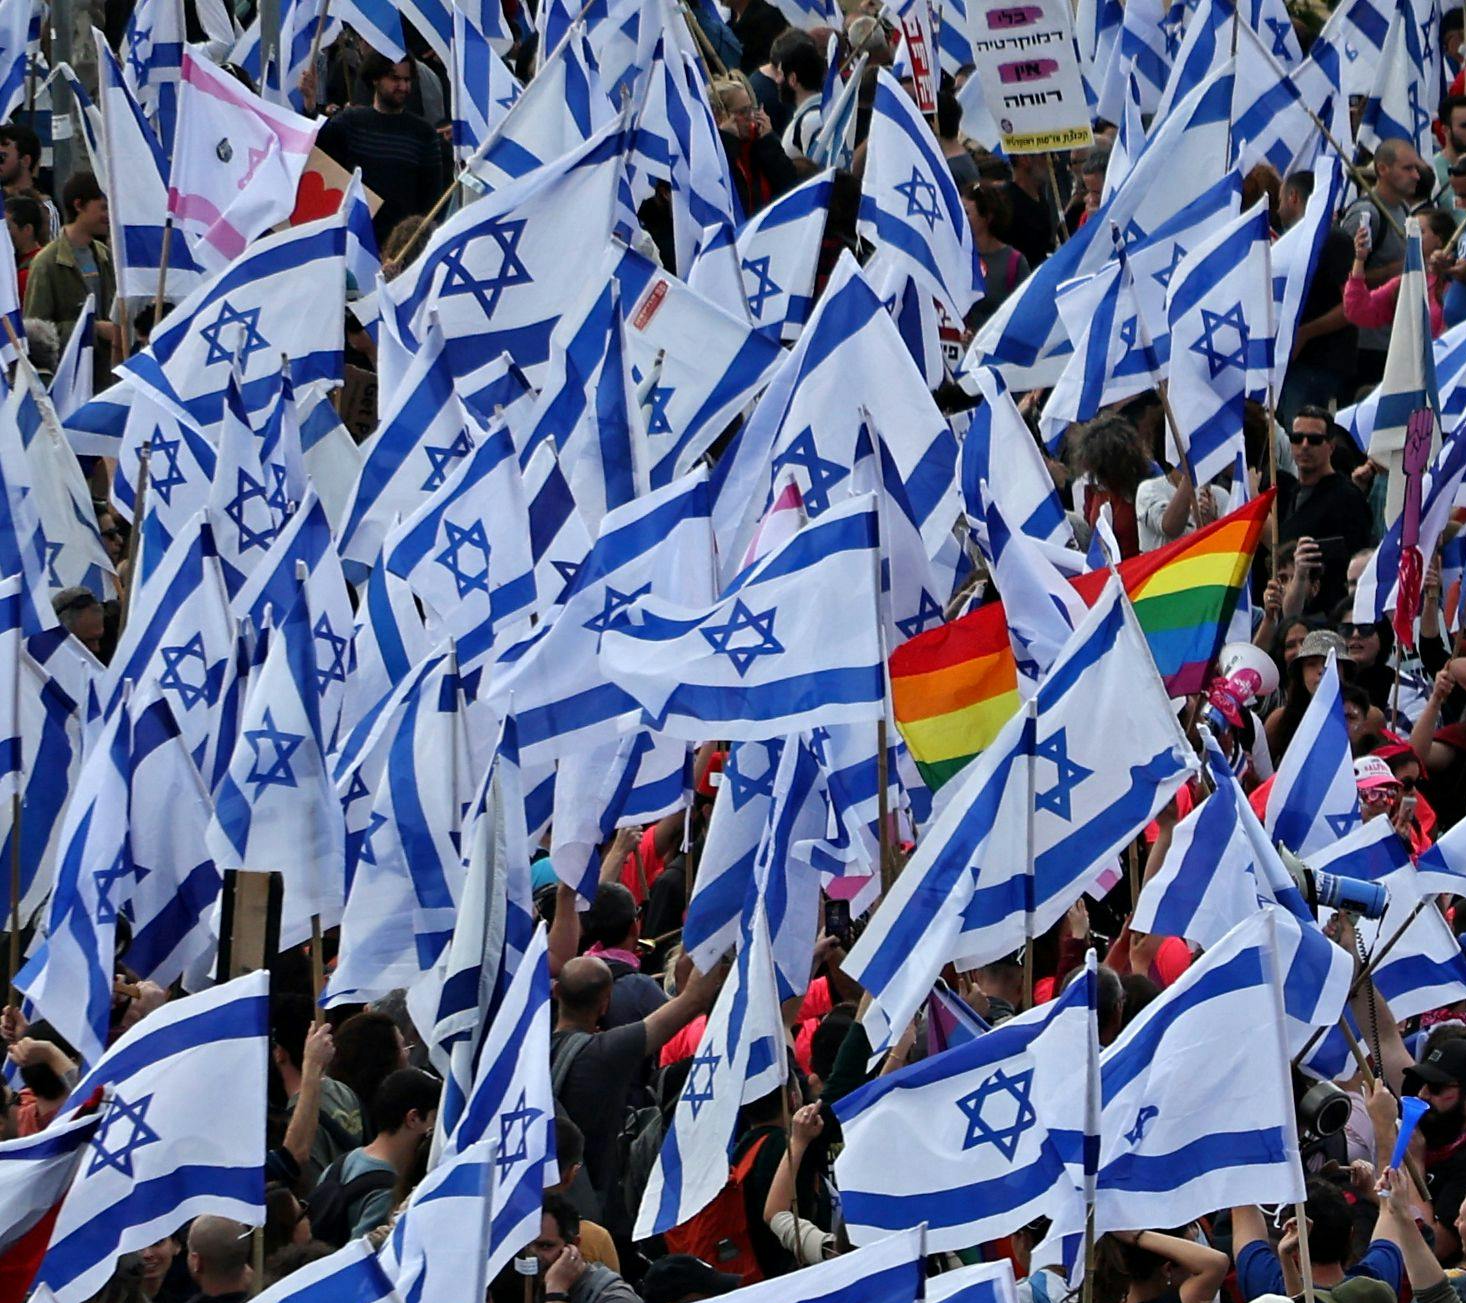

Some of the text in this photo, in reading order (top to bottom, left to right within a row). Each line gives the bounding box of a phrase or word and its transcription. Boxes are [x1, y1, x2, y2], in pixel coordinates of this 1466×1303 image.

[998, 11, 1025, 25] בלי
[977, 30, 1063, 52] דמוקרטיה
[1014, 62, 1041, 82] אין
[1004, 89, 1062, 108] רווחה
